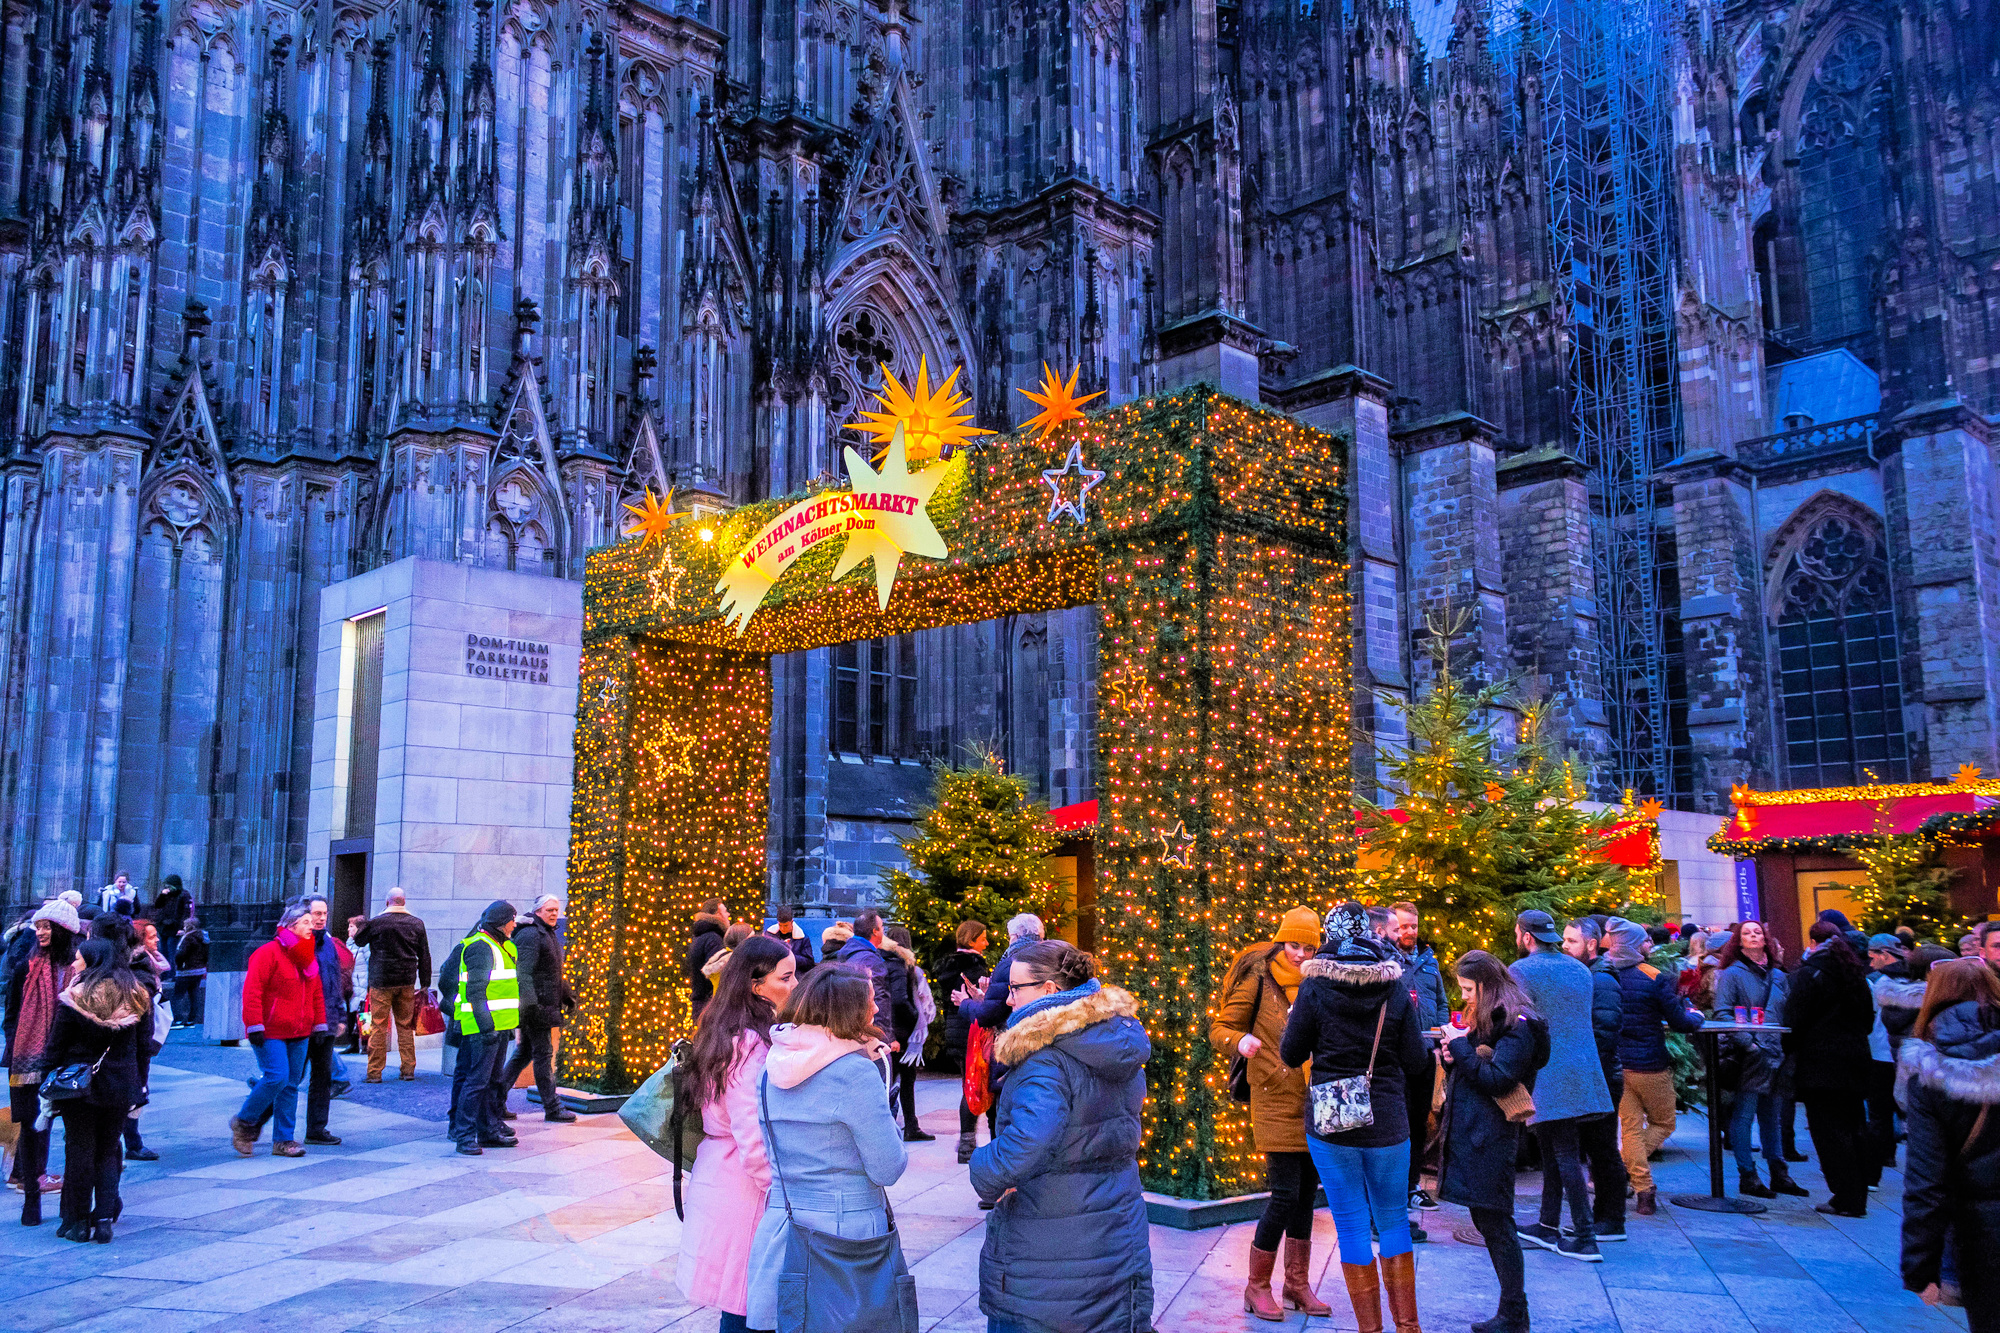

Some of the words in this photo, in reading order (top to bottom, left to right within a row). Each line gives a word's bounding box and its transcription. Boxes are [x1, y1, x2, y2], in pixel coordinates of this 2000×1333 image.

[742, 493, 918, 569] WEIHNACHTSMARKT
[778, 545, 795, 563] am
[801, 523, 843, 547] Kölner
[846, 517, 875, 531] Dom
[467, 633, 549, 654] DOM-TURM
[467, 648, 548, 669] PARKHAUS
[466, 662, 548, 682] TOILETTEN
